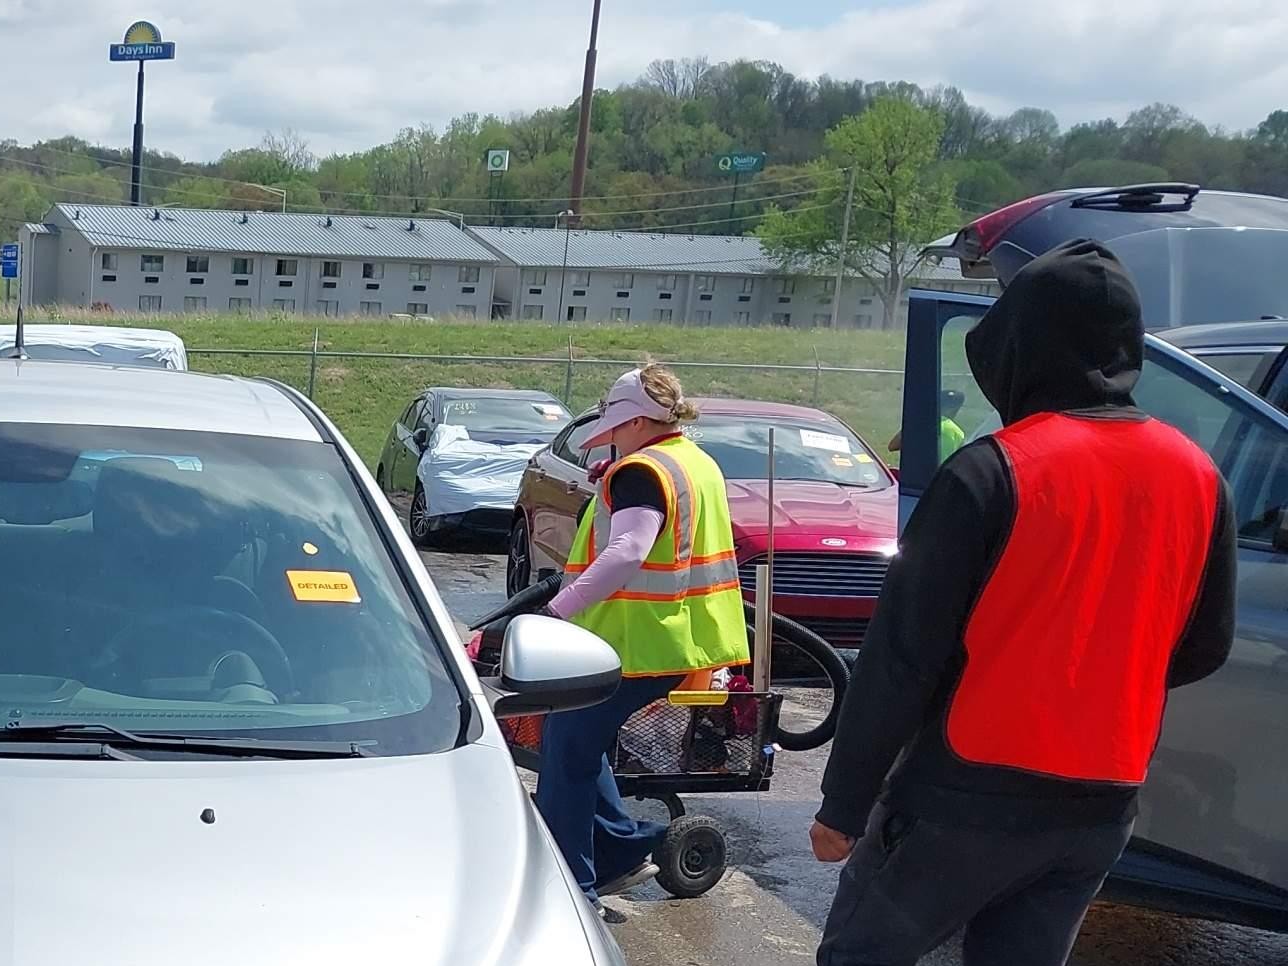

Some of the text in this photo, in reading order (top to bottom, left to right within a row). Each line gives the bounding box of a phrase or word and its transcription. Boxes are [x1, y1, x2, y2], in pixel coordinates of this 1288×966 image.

[118, 44, 163, 55] Days Inn
[297, 582, 349, 590] DETAILED
